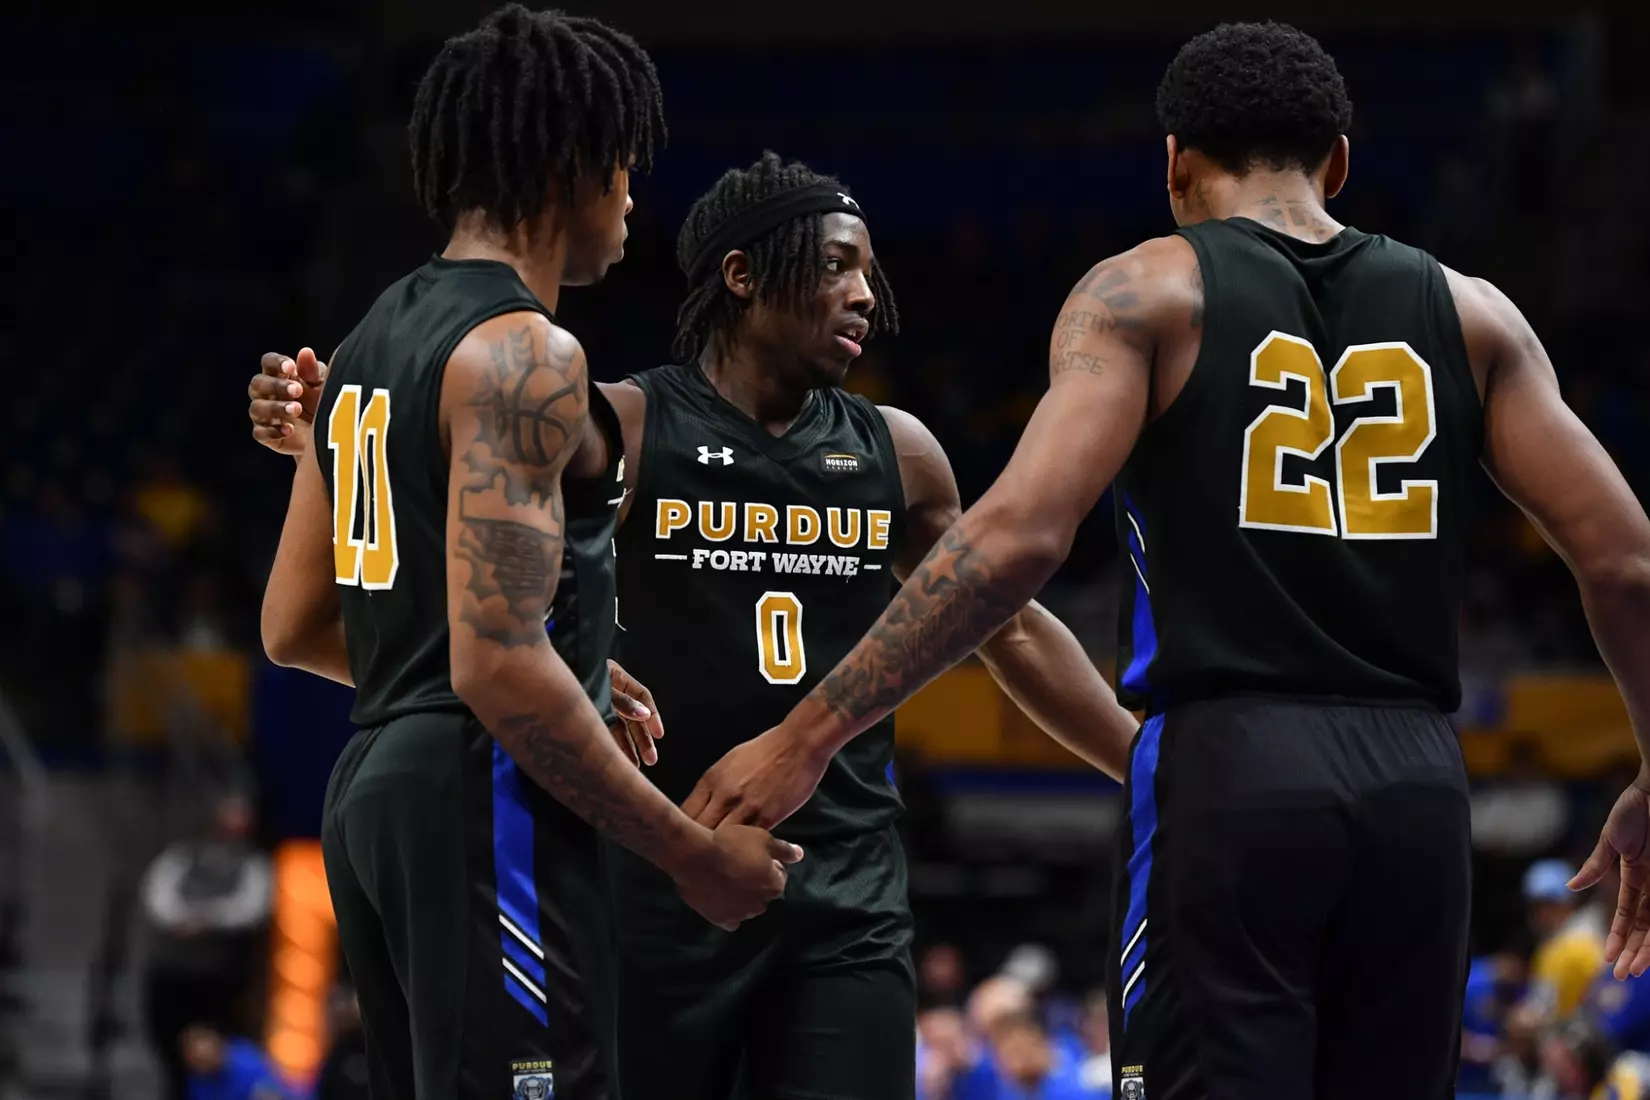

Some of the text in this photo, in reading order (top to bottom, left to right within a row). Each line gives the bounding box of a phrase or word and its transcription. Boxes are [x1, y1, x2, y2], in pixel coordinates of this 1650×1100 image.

[1057, 330, 1085, 348] OF
[1238, 329, 1438, 540] 22
[825, 458, 858, 467] HORIZON
[327, 384, 400, 590] 10
[655, 498, 892, 550] PURDUE
[692, 549, 860, 576] FORT WAYNE
[755, 591, 807, 685] 0
[512, 1061, 552, 1070] PURDUE
